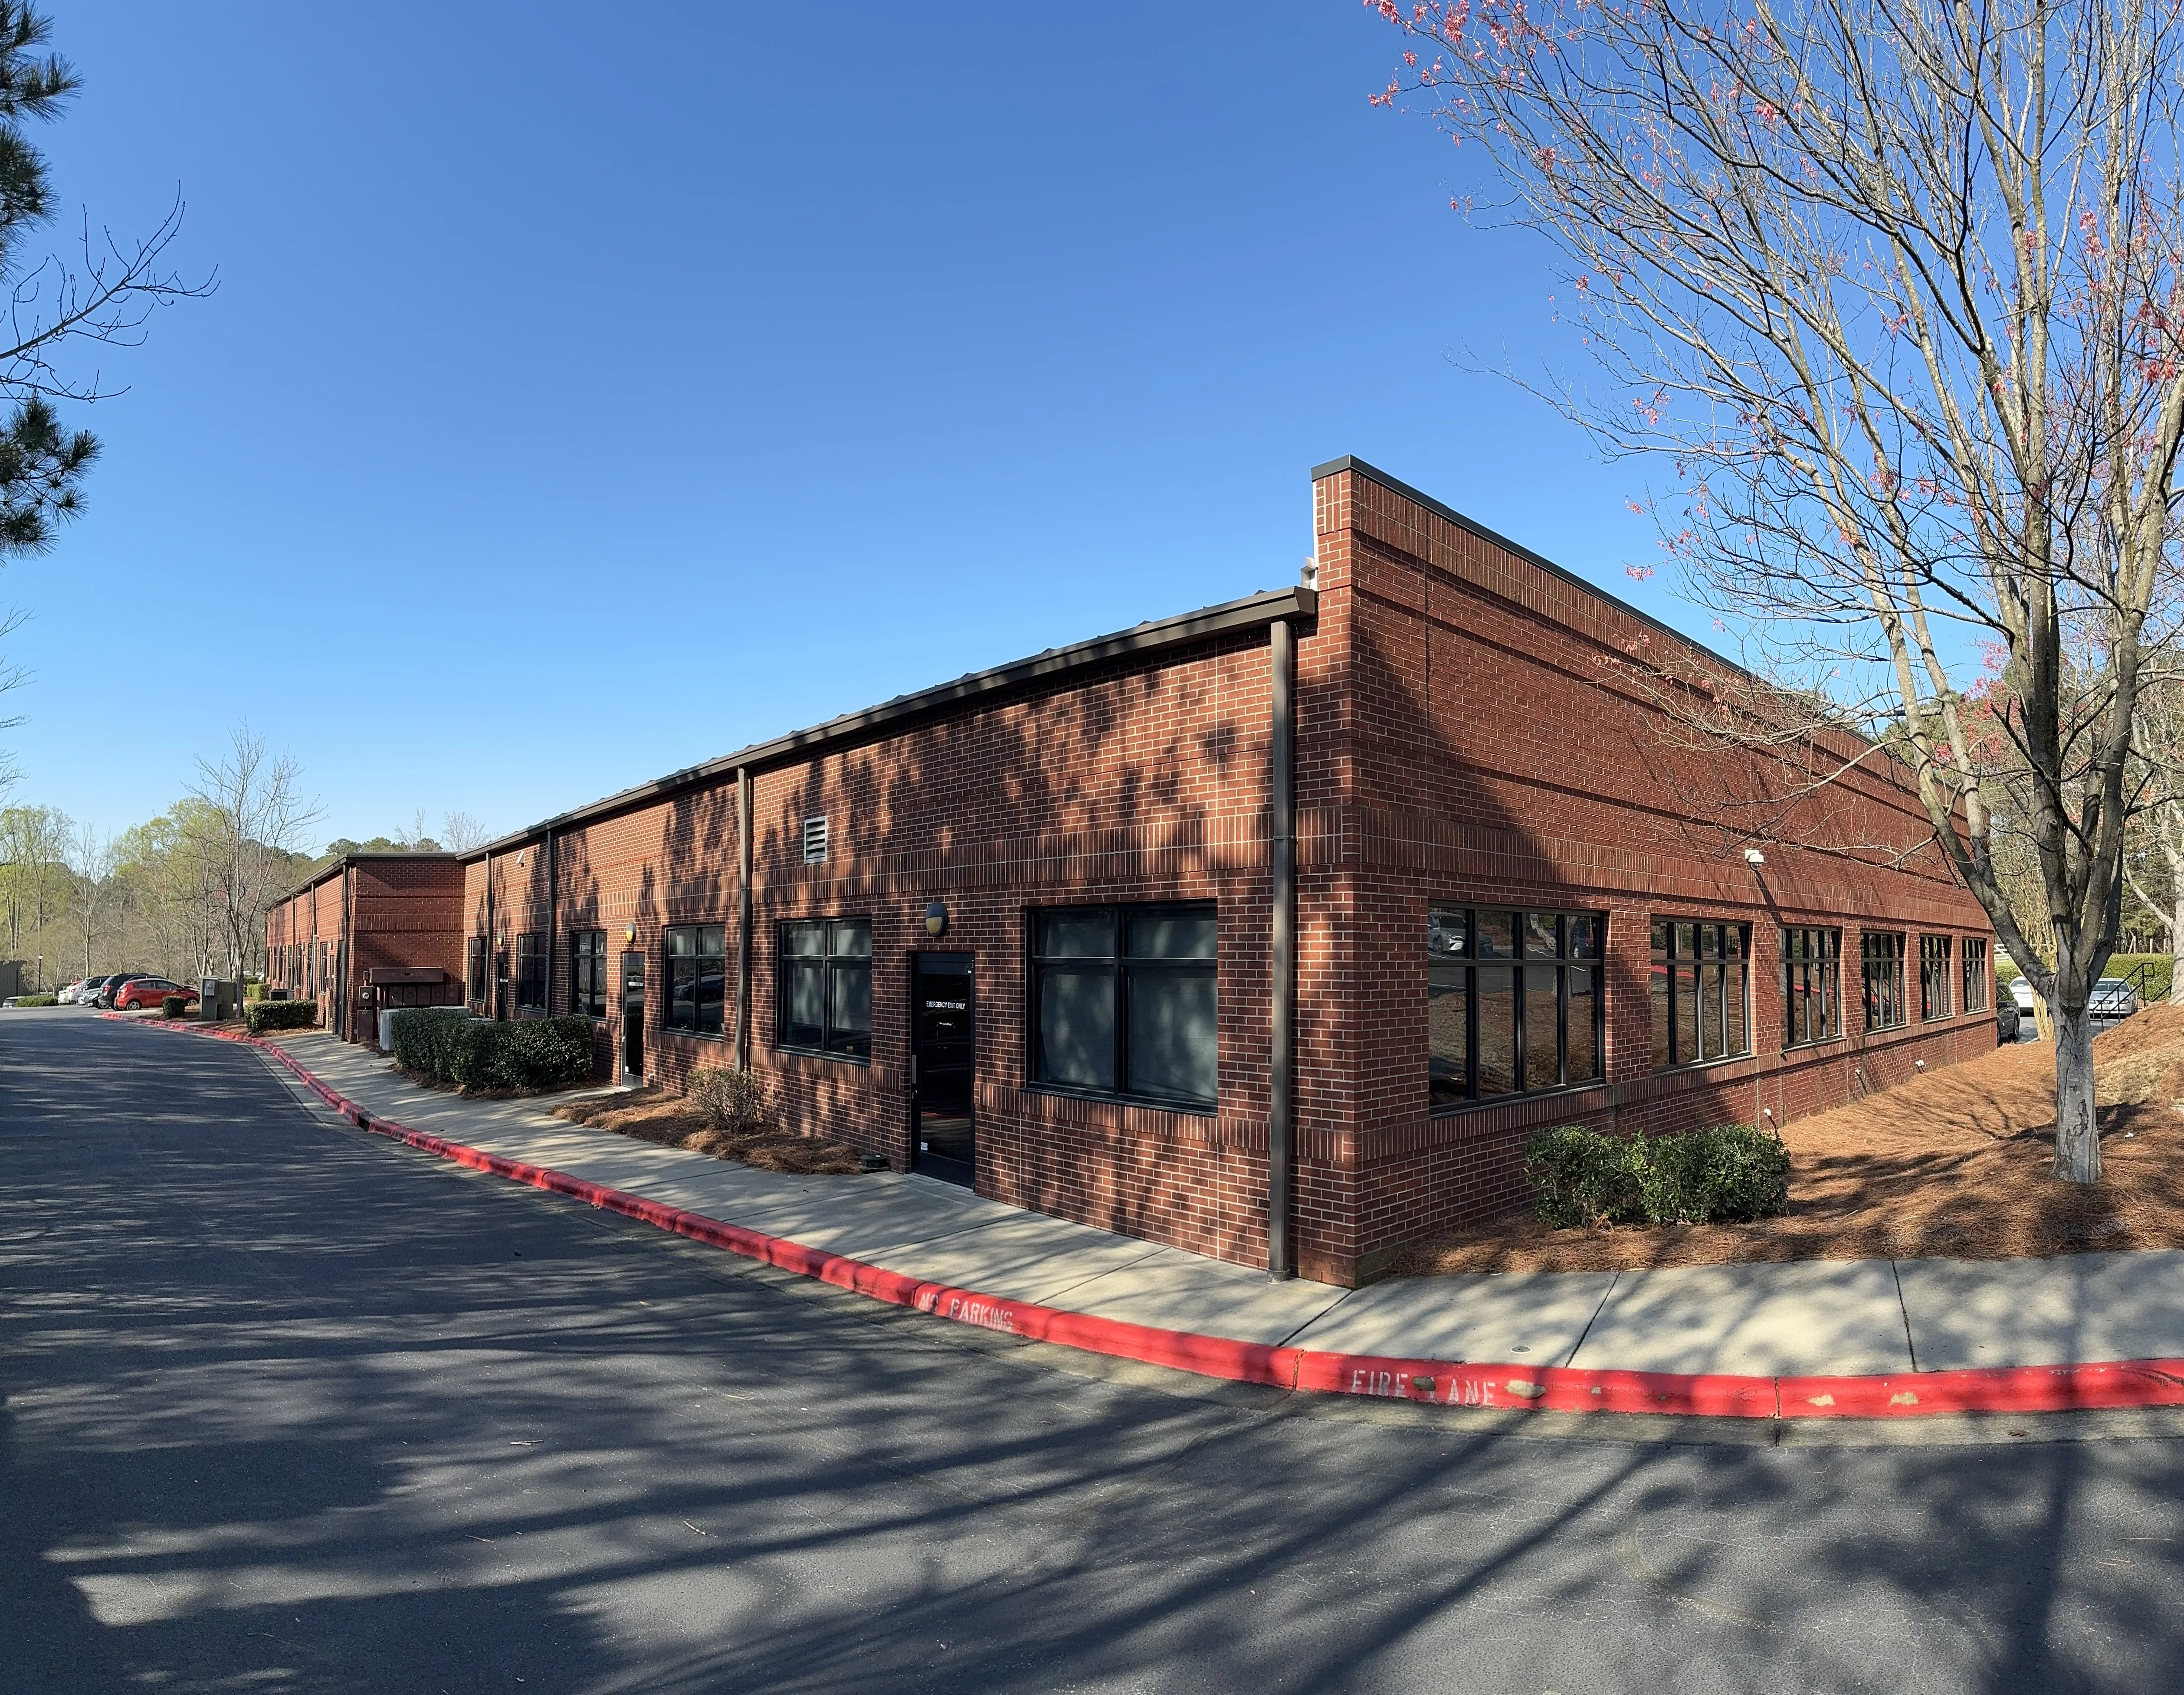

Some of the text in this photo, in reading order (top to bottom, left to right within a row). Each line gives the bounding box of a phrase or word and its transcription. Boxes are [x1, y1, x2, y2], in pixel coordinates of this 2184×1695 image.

[918, 1293, 1013, 1332] NO PARKING
[1351, 1370, 1408, 1397] FIRE
